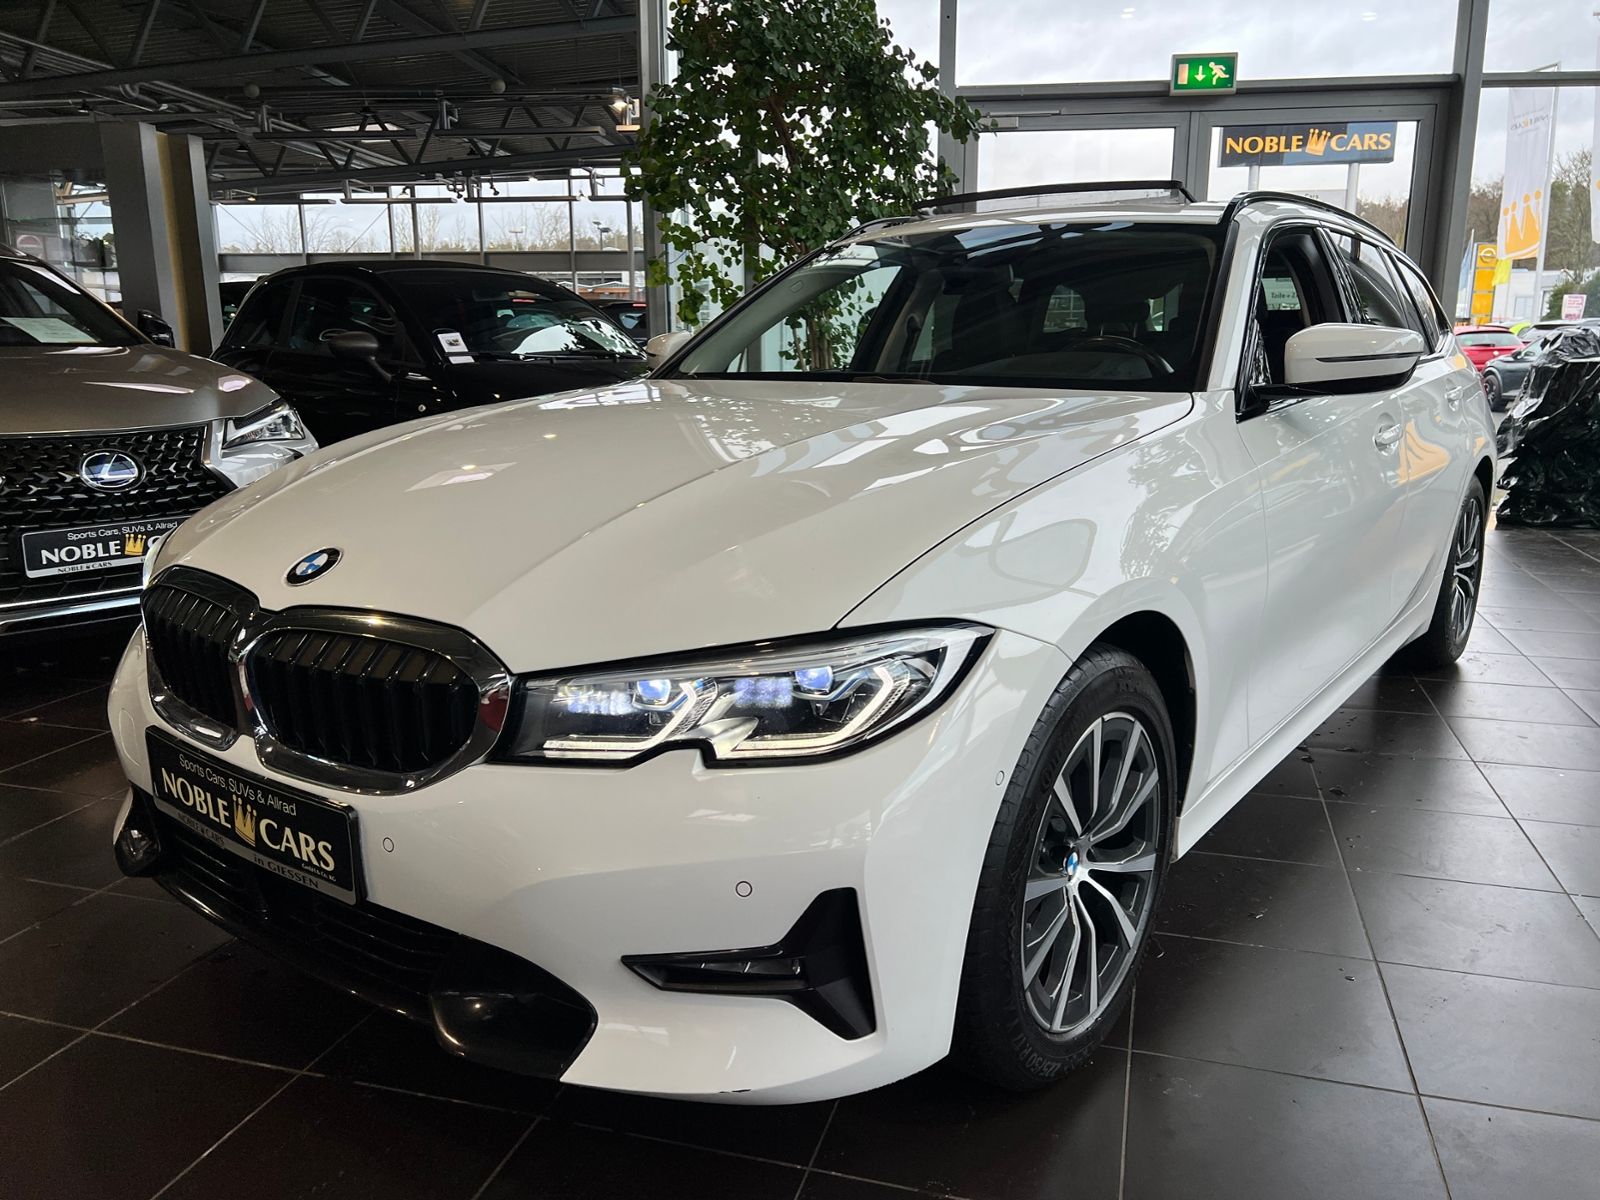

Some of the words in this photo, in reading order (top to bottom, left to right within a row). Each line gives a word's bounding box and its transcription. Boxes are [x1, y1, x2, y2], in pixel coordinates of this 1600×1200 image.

[1225, 135, 1303, 154] NOBLE
[1330, 133, 1392, 151] CARS
[67, 530, 97, 541] Sports
[121, 525, 145, 534] SUVs
[155, 521, 178, 530] Allrad
[41, 540, 122, 565] NOBLE
[57, 564, 84, 573] NOBLE
[92, 561, 113, 569] CARS
[179, 754, 205, 778] Sports
[228, 777, 255, 801] SUVs
[256, 790, 265, 804] &
[267, 793, 297, 816] Allrad
[161, 767, 232, 829] NOBLE
[259, 818, 335, 872] CARS
[253, 854, 264, 865] in
[267, 862, 319, 889] GIESSEN
